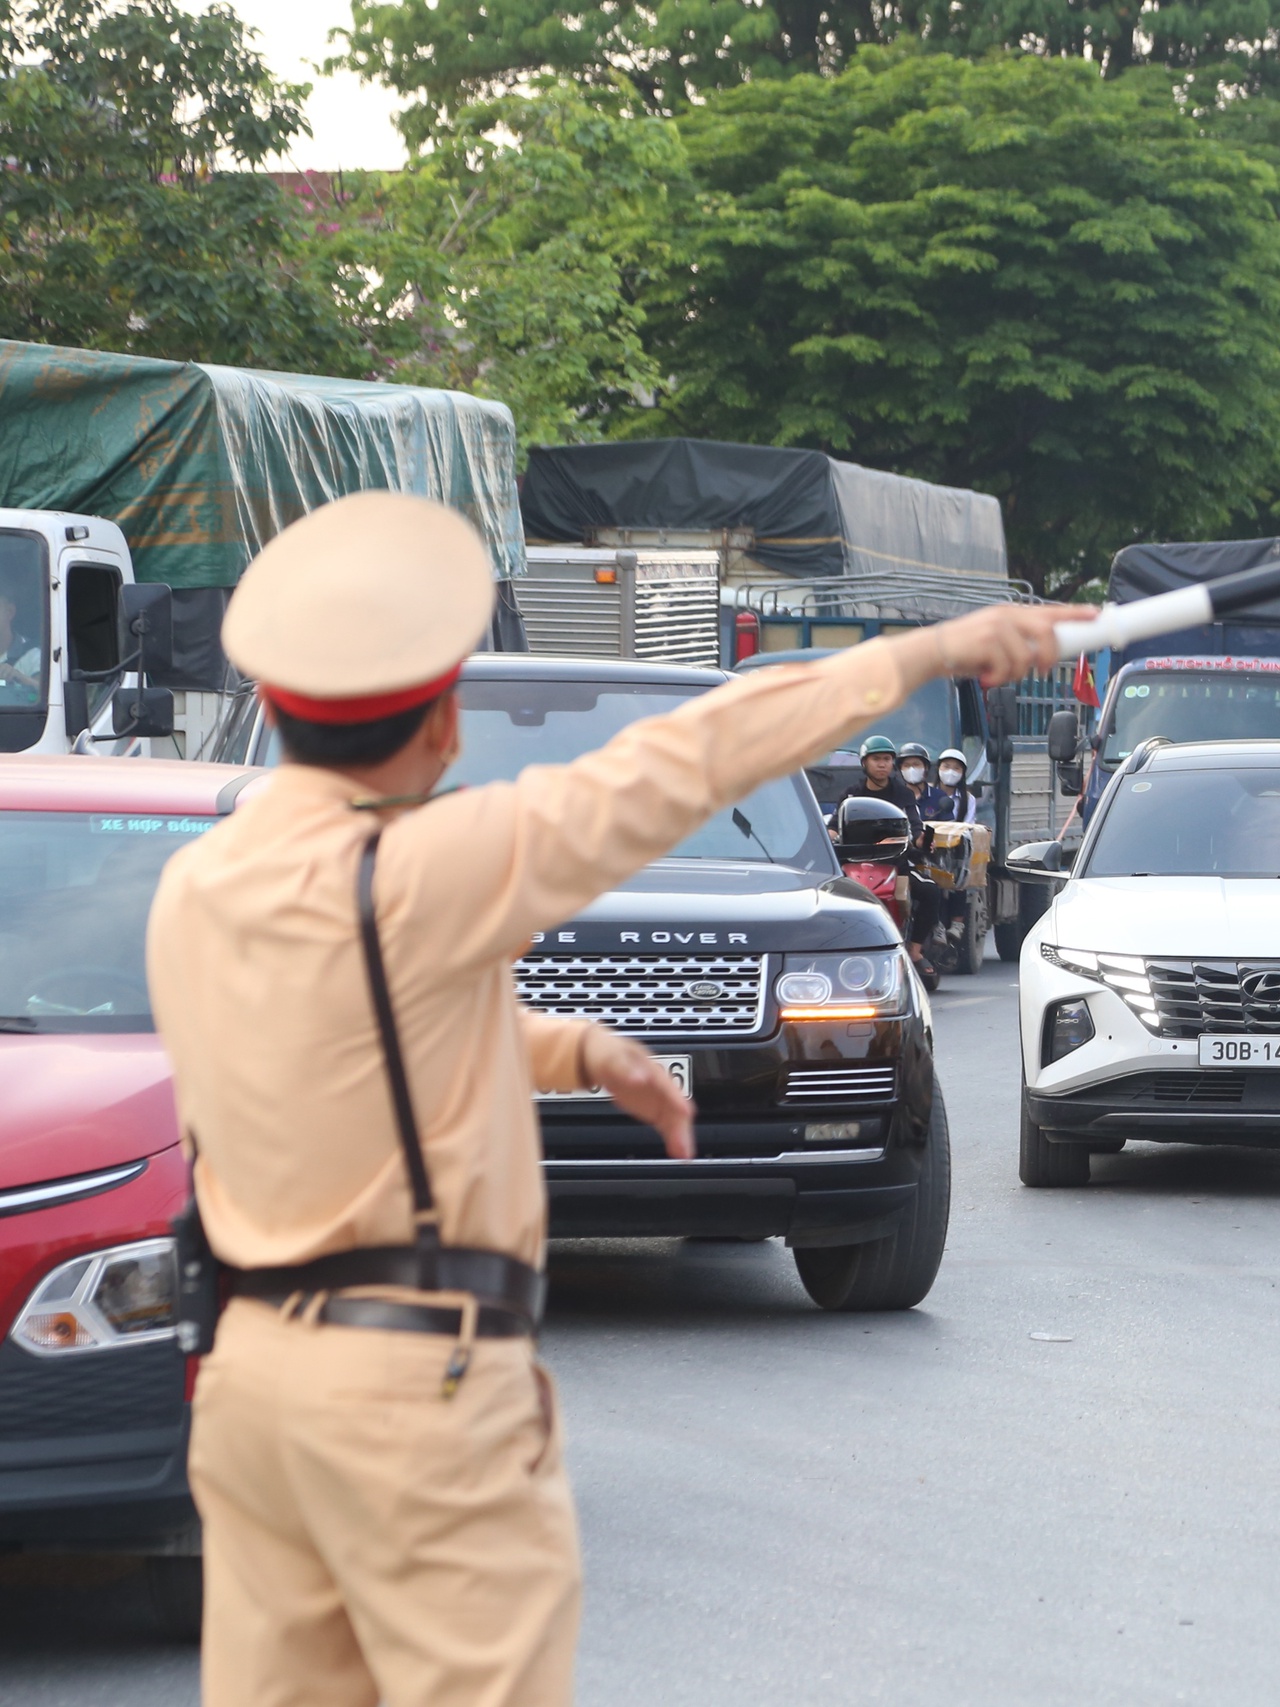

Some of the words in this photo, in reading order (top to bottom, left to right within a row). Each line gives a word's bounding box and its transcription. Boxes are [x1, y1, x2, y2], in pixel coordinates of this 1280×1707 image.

[100, 819, 124, 831] XE
[127, 818, 163, 834] HỢP
[620, 931, 749, 944] ROVER
